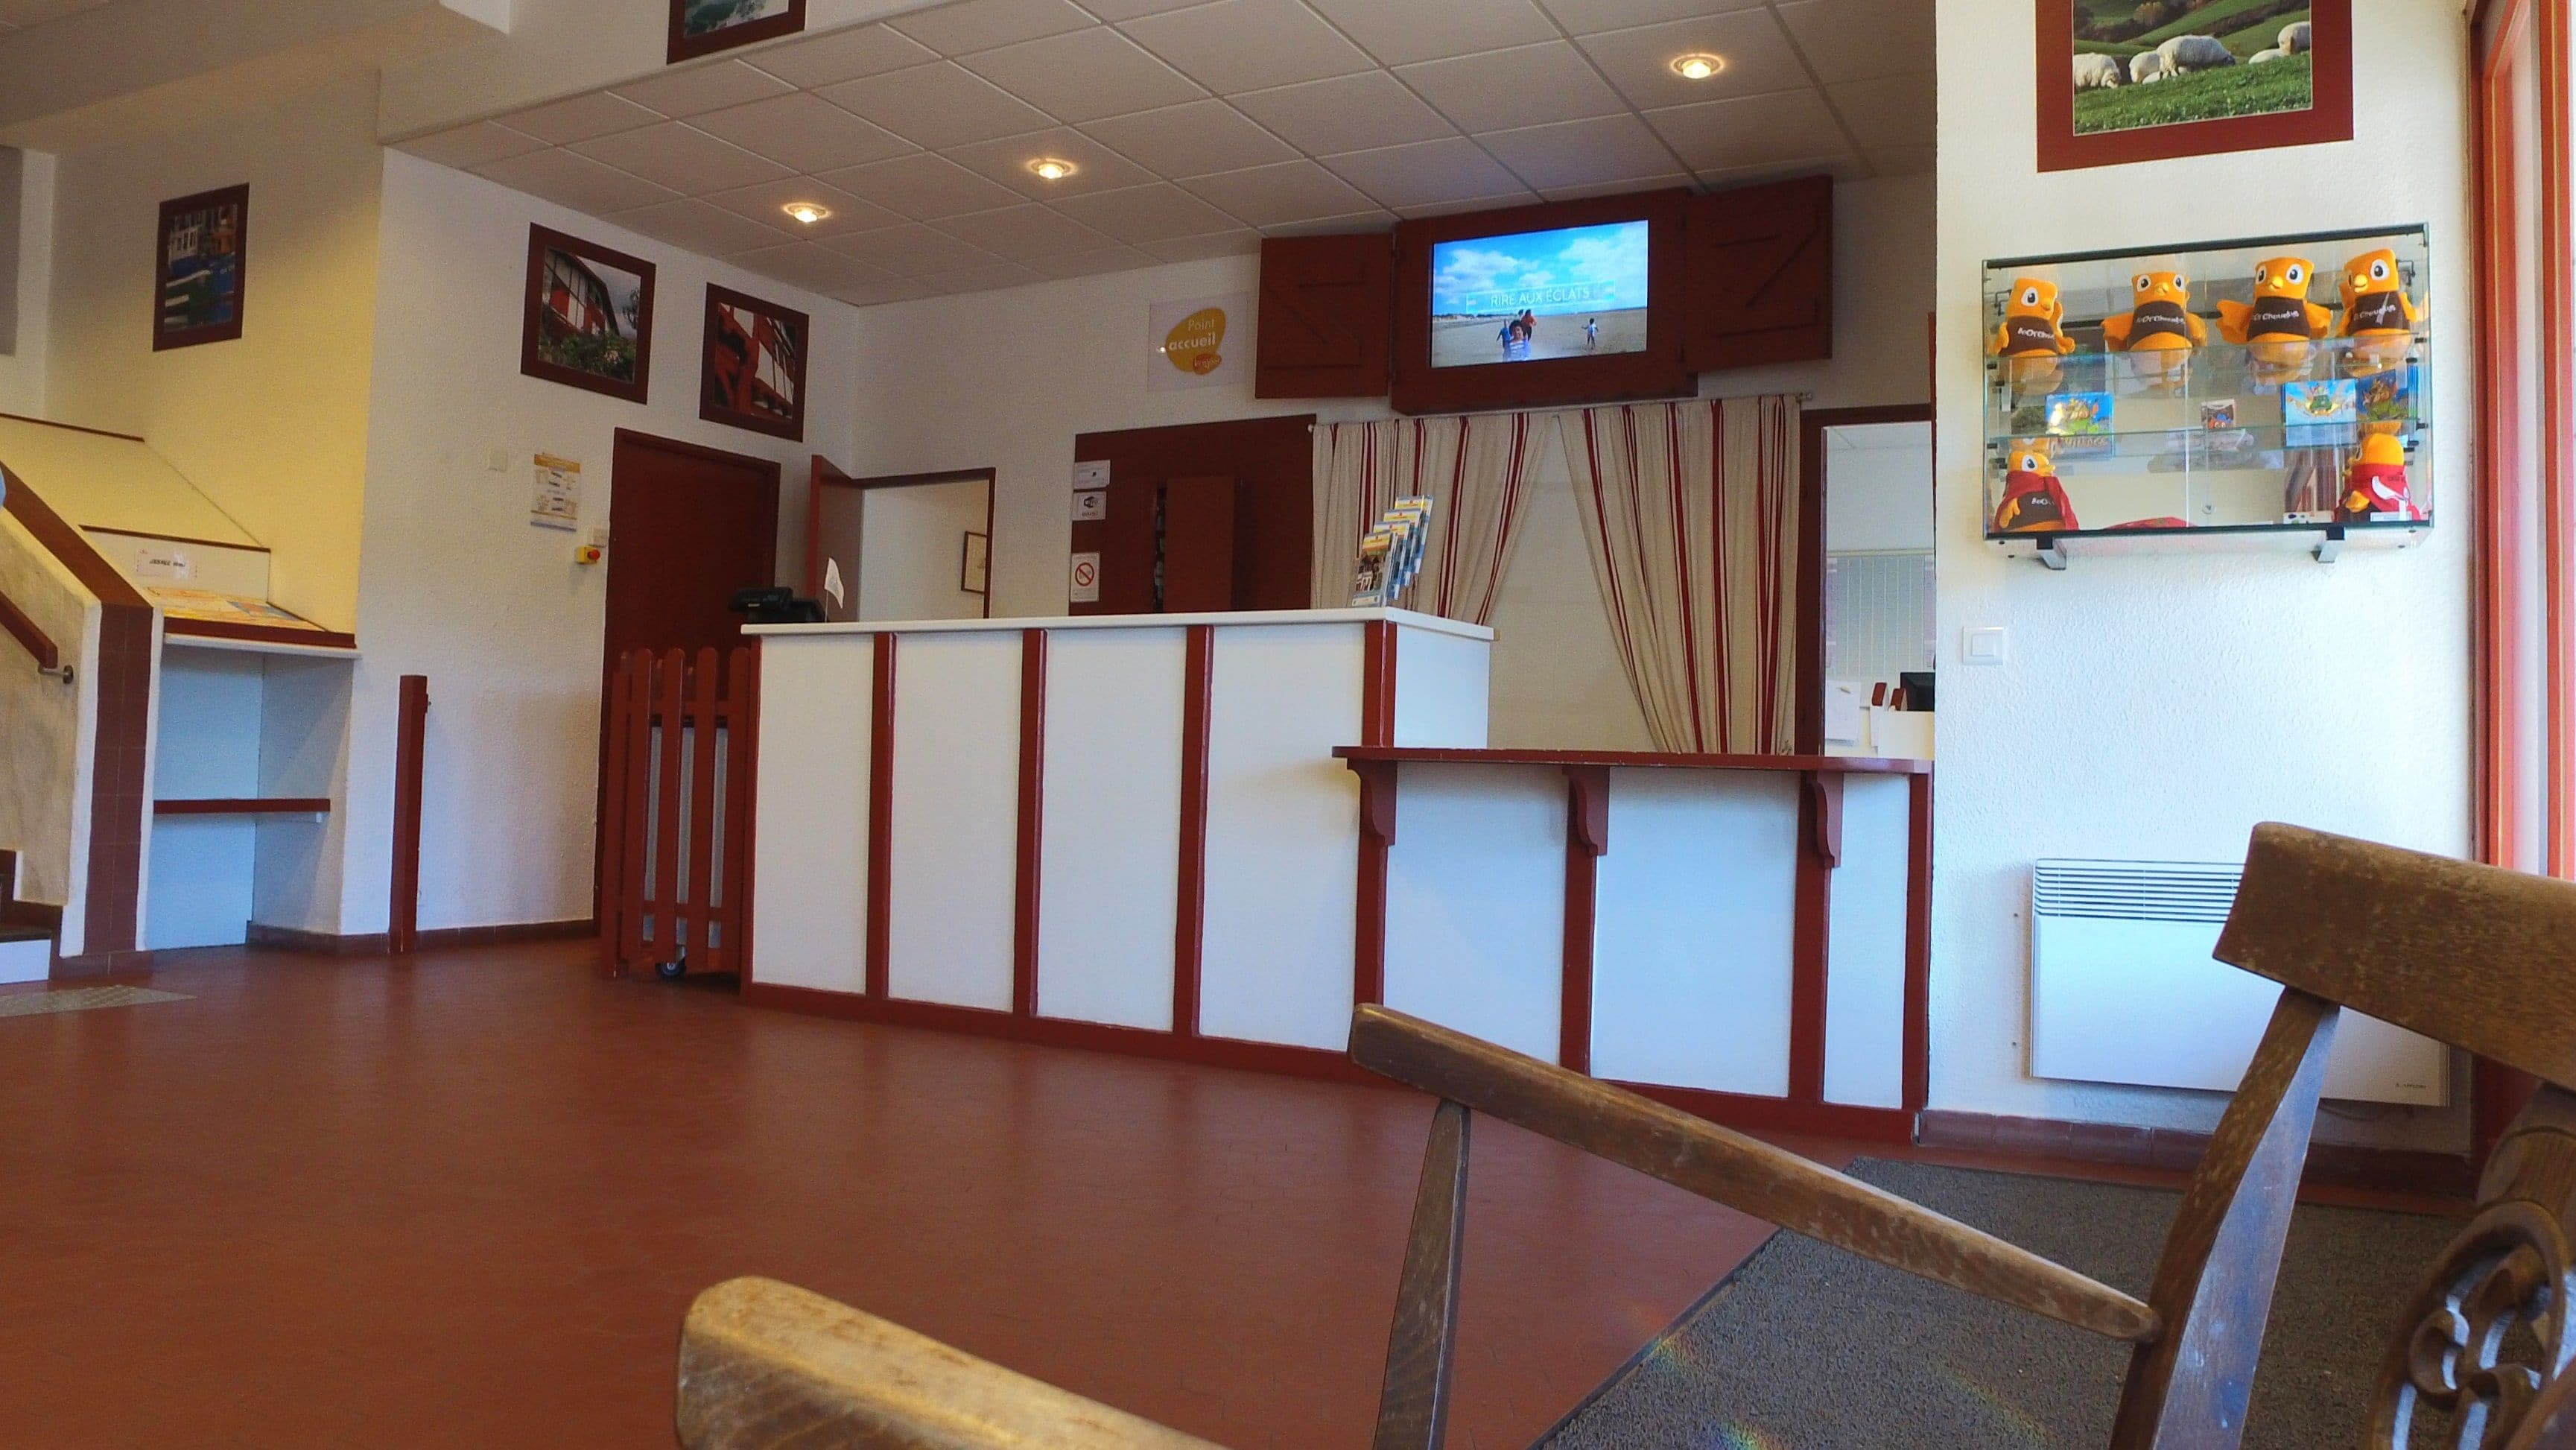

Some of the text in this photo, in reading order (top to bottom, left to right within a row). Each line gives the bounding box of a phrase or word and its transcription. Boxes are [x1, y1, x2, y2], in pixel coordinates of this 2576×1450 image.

[1491, 286, 1590, 307] RIRE AUX ÉCLATS
[1187, 318, 1215, 331] Point
[1168, 332, 1216, 350] accueil
